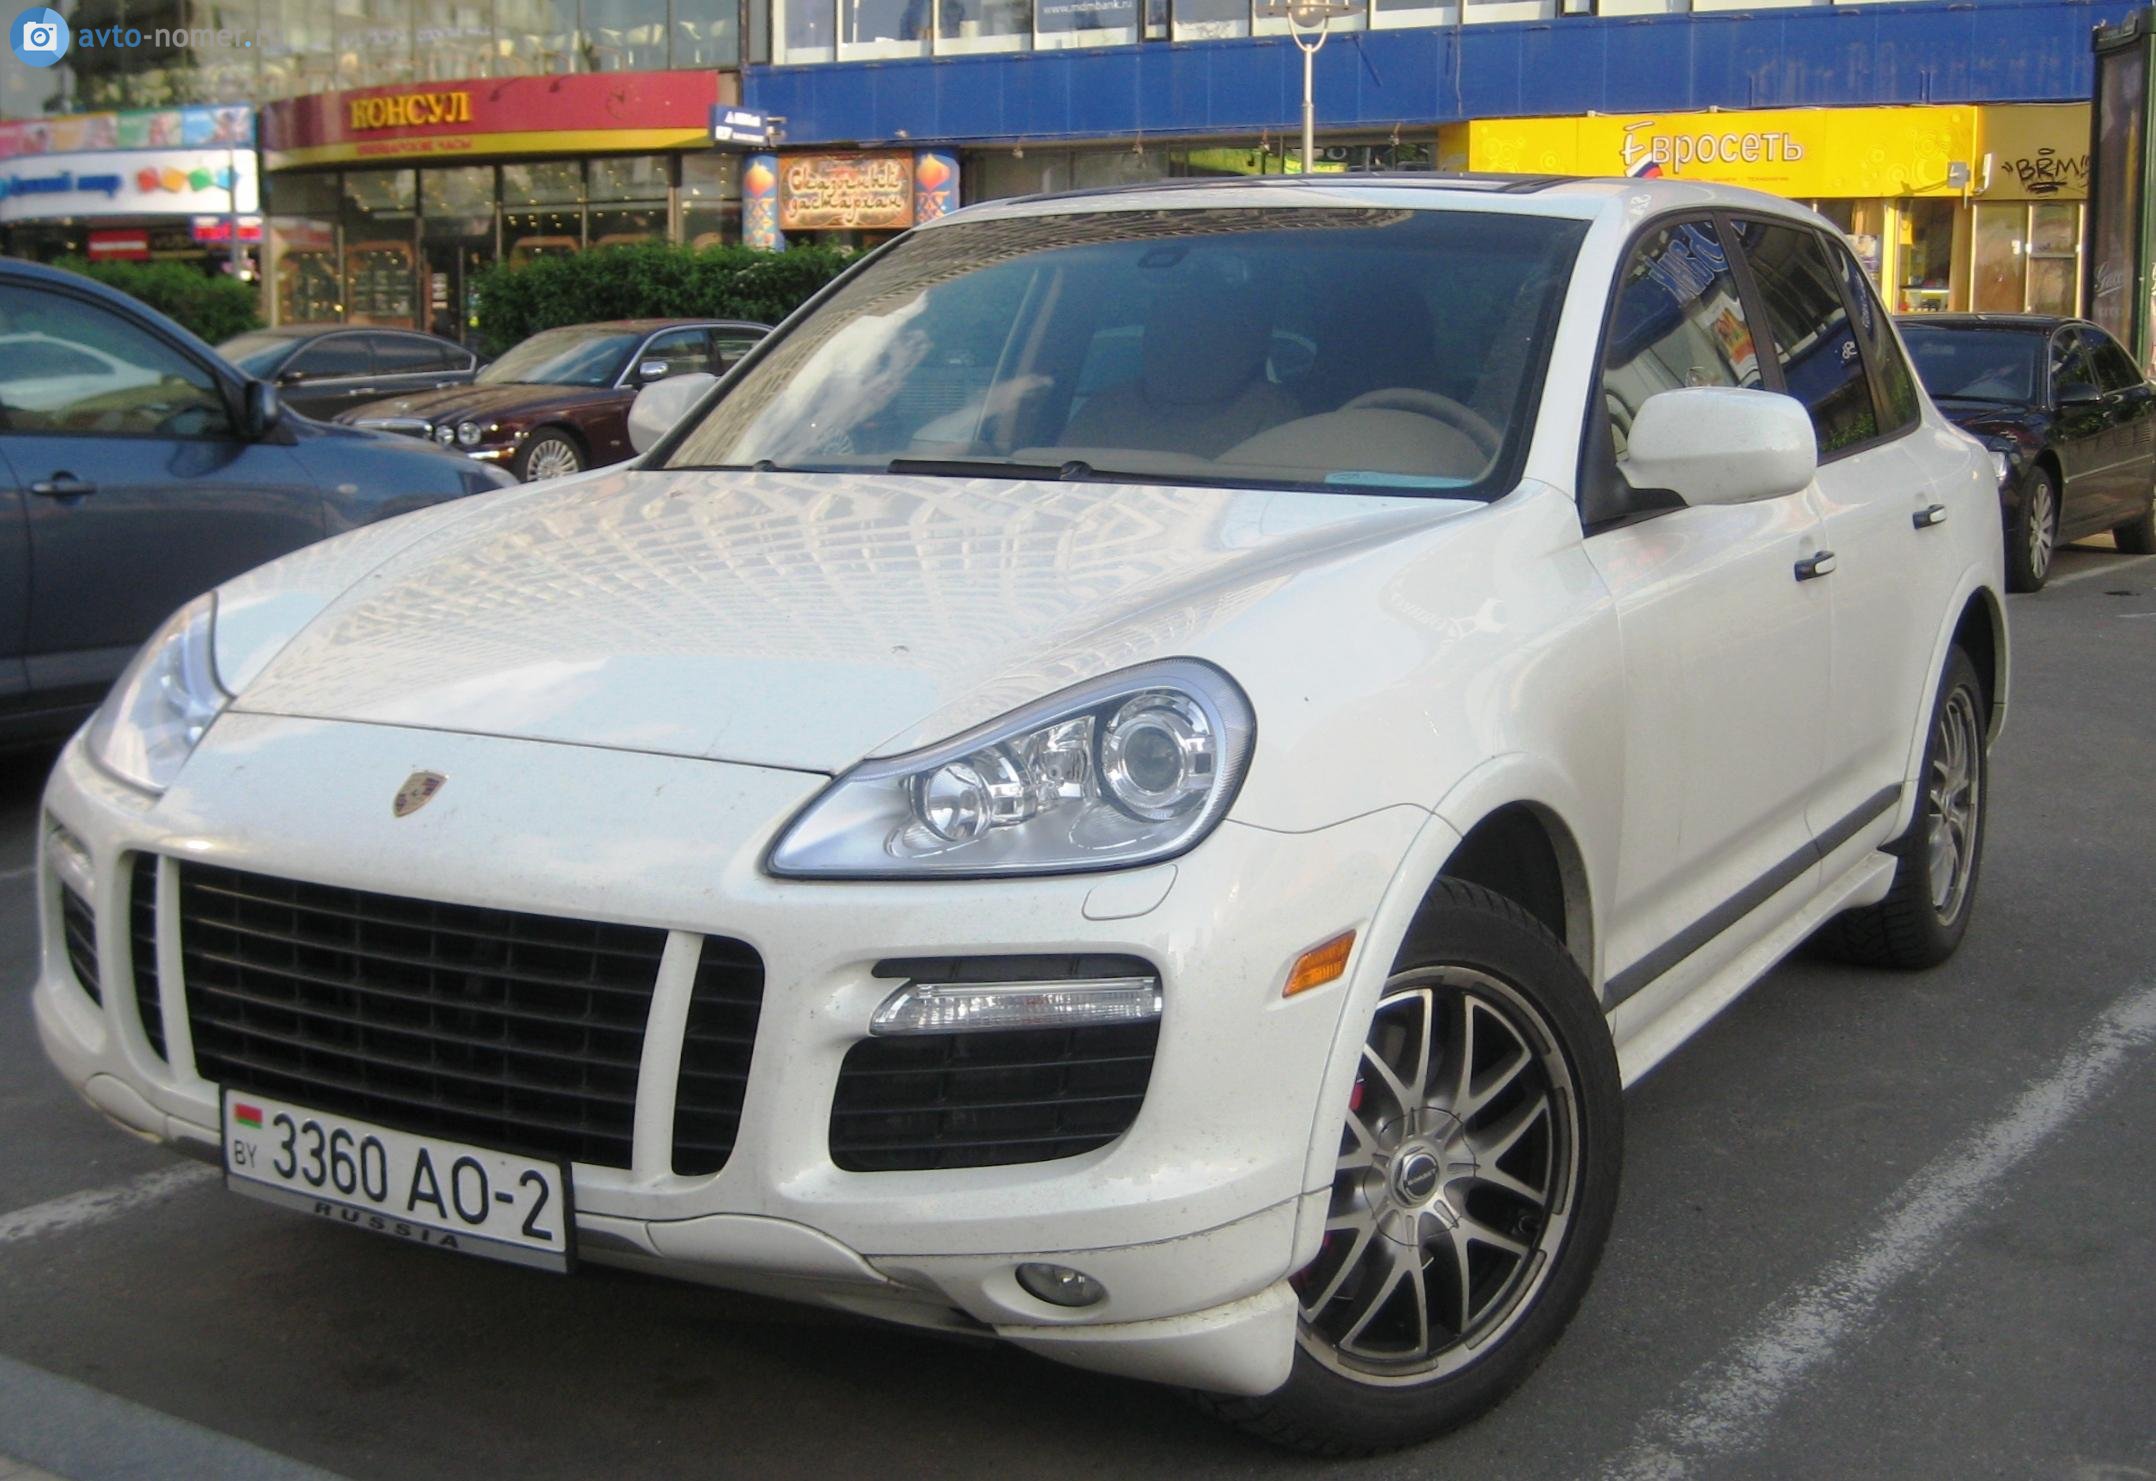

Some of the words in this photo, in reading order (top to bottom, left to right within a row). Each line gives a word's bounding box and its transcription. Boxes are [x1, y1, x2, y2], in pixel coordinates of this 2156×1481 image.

[351, 91, 471, 129] КОНСУЛ
[1620, 121, 1804, 174] Евросеть
[789, 161, 902, 194] Сказочный
[234, 1140, 258, 1169] BY
[272, 1112, 388, 1202] 3360
[407, 1147, 553, 1242] AO-2
[314, 1200, 460, 1249] RUSSIA
